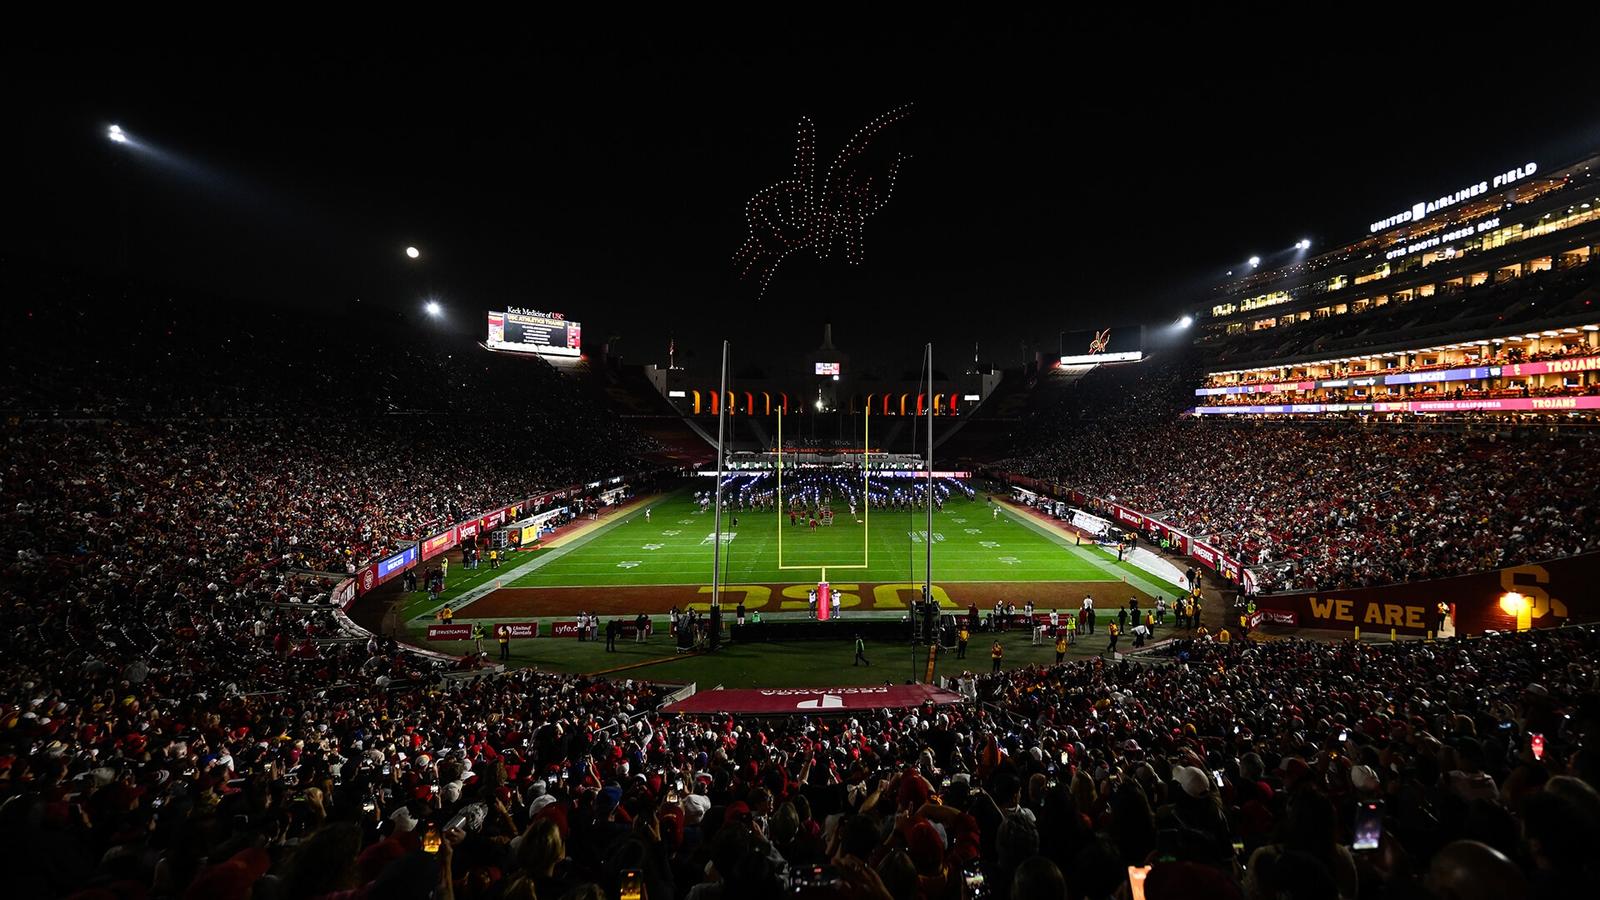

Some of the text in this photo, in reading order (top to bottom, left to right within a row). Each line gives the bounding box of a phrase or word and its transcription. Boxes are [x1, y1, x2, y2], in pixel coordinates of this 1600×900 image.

[1370, 163, 1536, 232] UNITED AIRLINES FIELD
[1386, 218, 1499, 259] OTIS BOOTH PRESS BOX
[508, 306, 521, 314] Keck
[523, 308, 545, 317] Medicine
[1546, 357, 1600, 372] TROJANS
[1420, 399, 1576, 410] SOUTHERN CALIFORNIA TROJANS
[685, 583, 958, 610] USC
[1309, 597, 1425, 628] WE ARE
